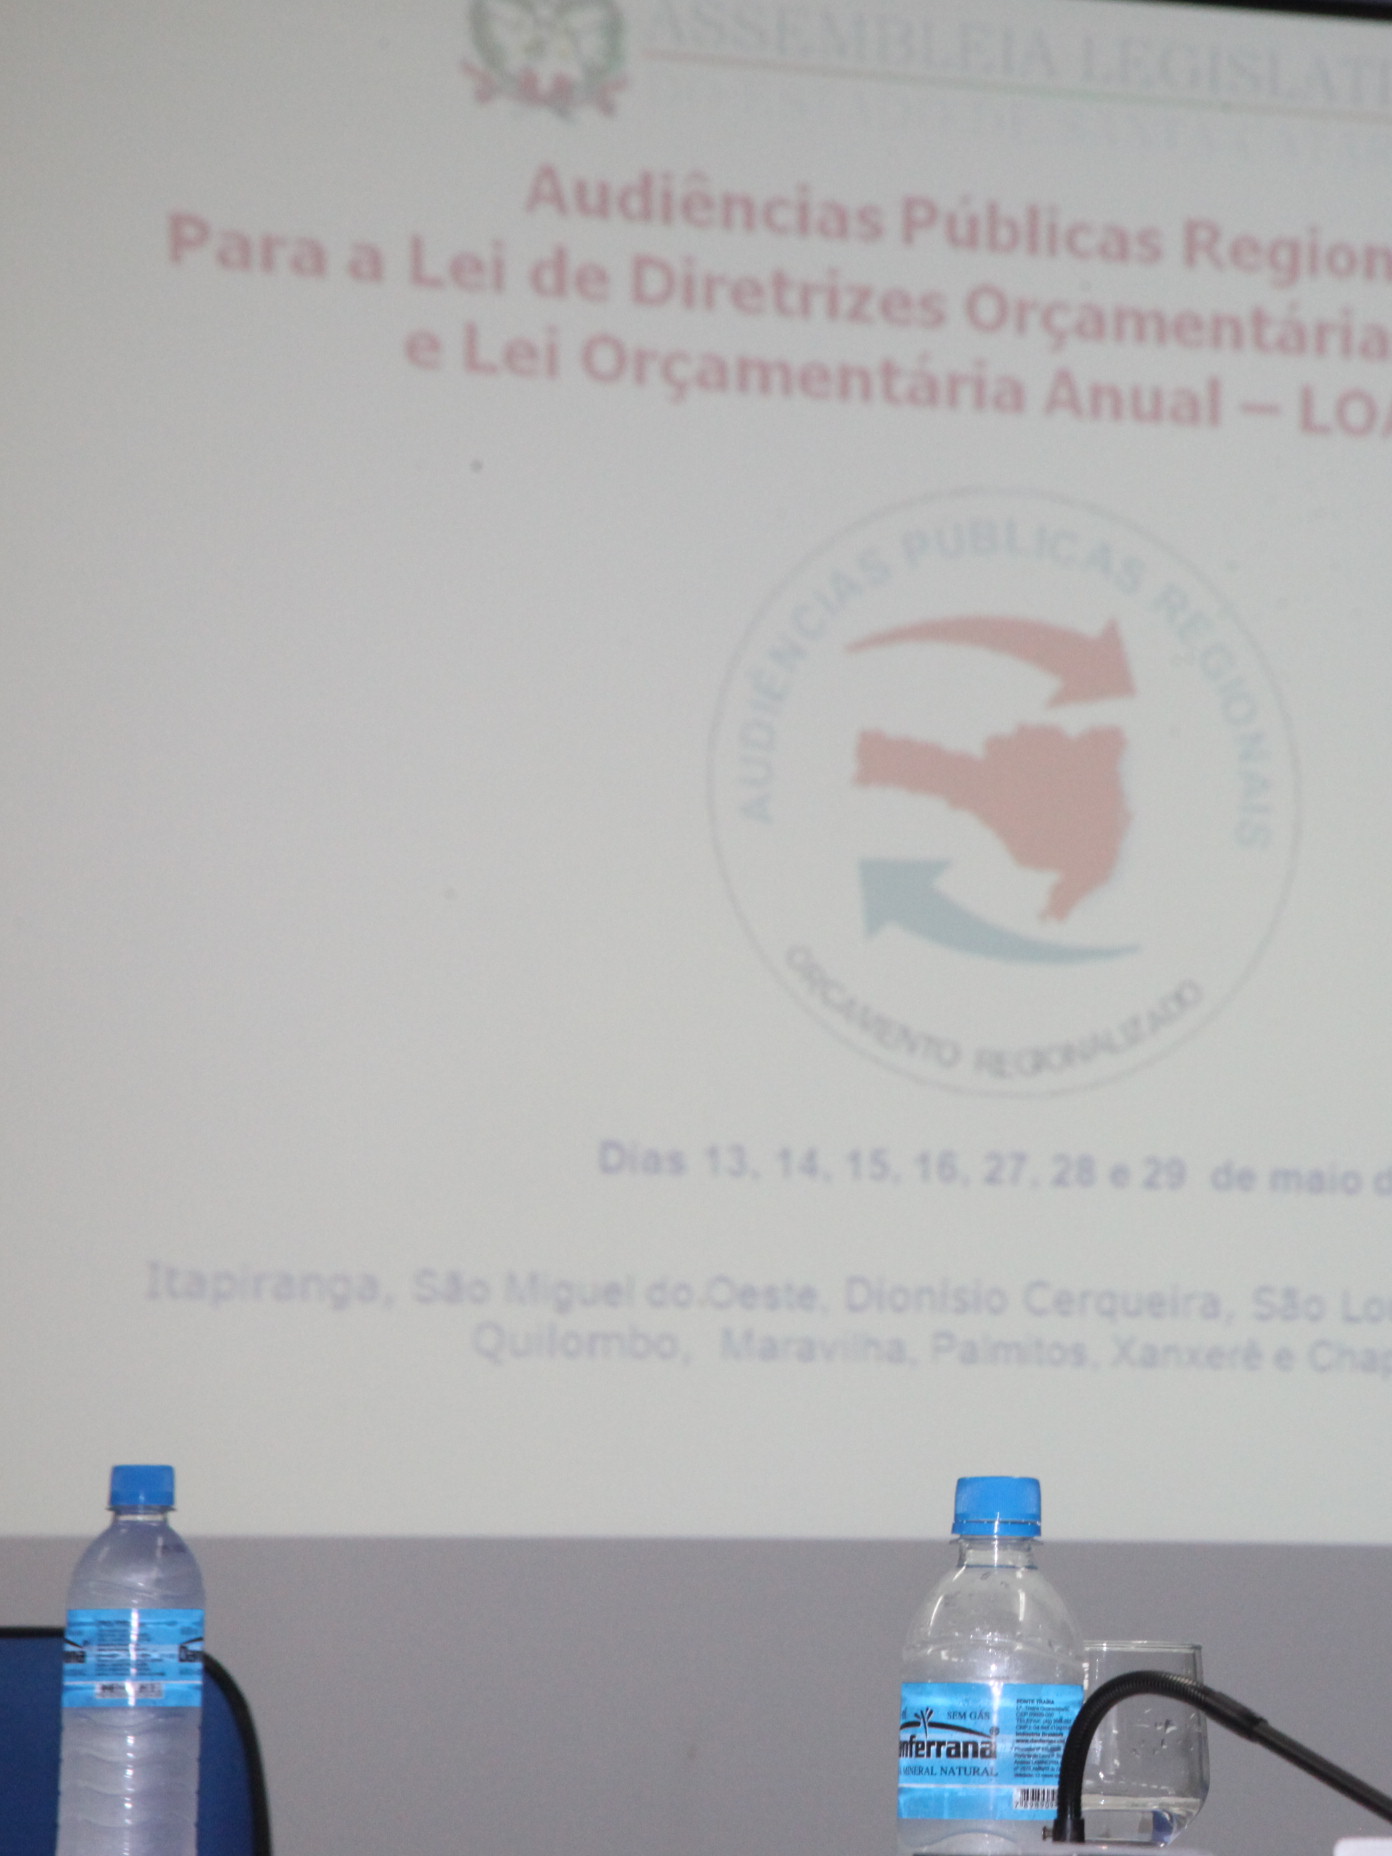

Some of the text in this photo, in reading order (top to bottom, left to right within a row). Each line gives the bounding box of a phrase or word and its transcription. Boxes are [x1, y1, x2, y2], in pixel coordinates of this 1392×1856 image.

[527, 162, 884, 242] Audiências
[901, 194, 1164, 268] Públicas
[168, 211, 329, 279] Para
[348, 240, 384, 283] a
[410, 234, 507, 293] Lei
[529, 246, 611, 301] de
[630, 254, 947, 330] Diretrizes
[403, 327, 443, 369] e
[463, 320, 559, 379] Lei
[581, 332, 1026, 414] Orçamentária
[1042, 368, 1222, 428] Anual
[598, 1138, 688, 1178] Dias
[705, 1143, 762, 1181] 13,
[777, 1146, 834, 1183] 14,
[847, 1148, 900, 1186] 15,
[917, 1150, 970, 1187] 16,
[983, 1152, 1040, 1189] 27,
[1051, 1153, 1097, 1189] 28
[1110, 1161, 1131, 1189] e
[1141, 1156, 1187, 1191] 29
[1210, 1160, 1258, 1195] de
[1268, 1163, 1364, 1198] maio
[146, 1260, 395, 1313] Itapiranga,
[413, 1267, 490, 1307] São
[505, 1272, 635, 1316] Miguel
[1022, 1279, 1235, 1330] Cerqueira,
[1252, 1285, 1325, 1325] São
[470, 1321, 690, 1366] Quilombo,
[1274, 1346, 1295, 1372] e
[947, 1710, 990, 1720] SEM GÁS
[903, 1766, 998, 1777] MINERAL NATURAL
